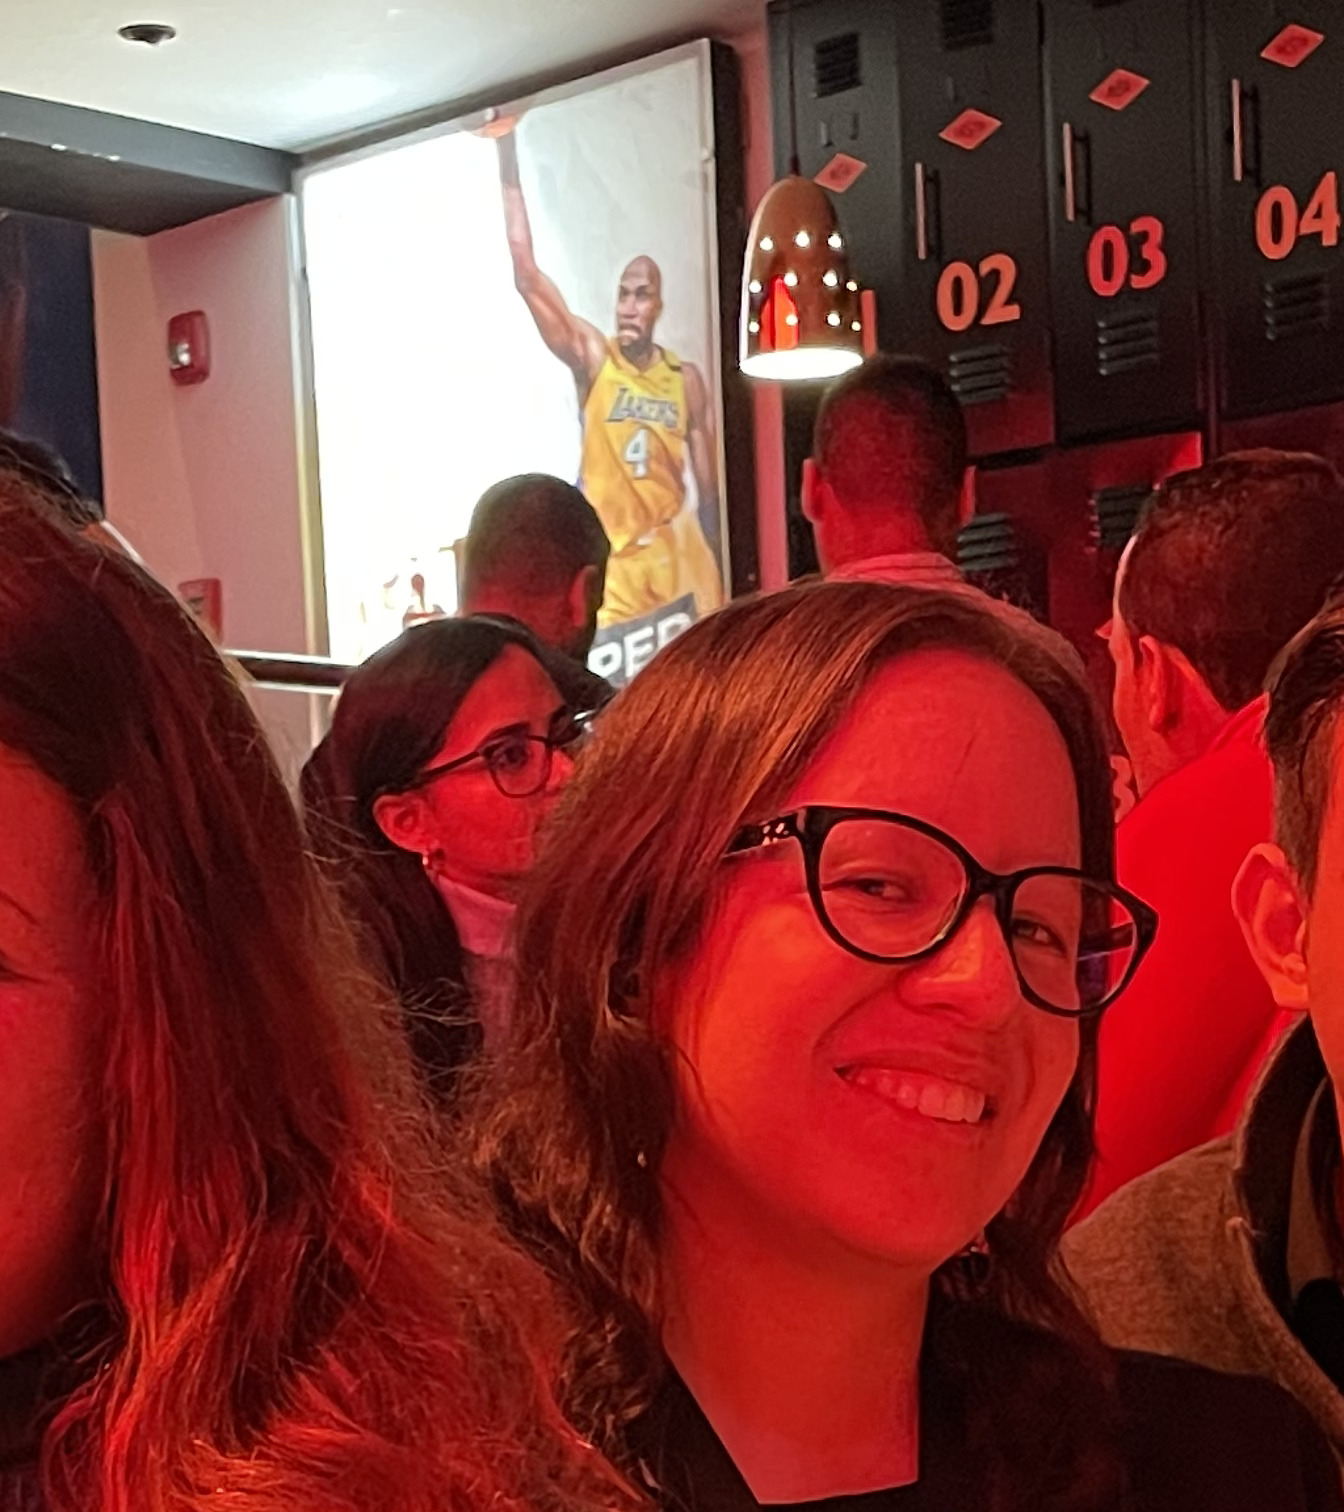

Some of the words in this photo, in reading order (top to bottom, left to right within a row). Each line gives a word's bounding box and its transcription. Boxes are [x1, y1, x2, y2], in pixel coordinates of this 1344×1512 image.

[1087, 215, 1168, 297] 03
[1256, 171, 1342, 260] 04
[936, 253, 1021, 332] 02
